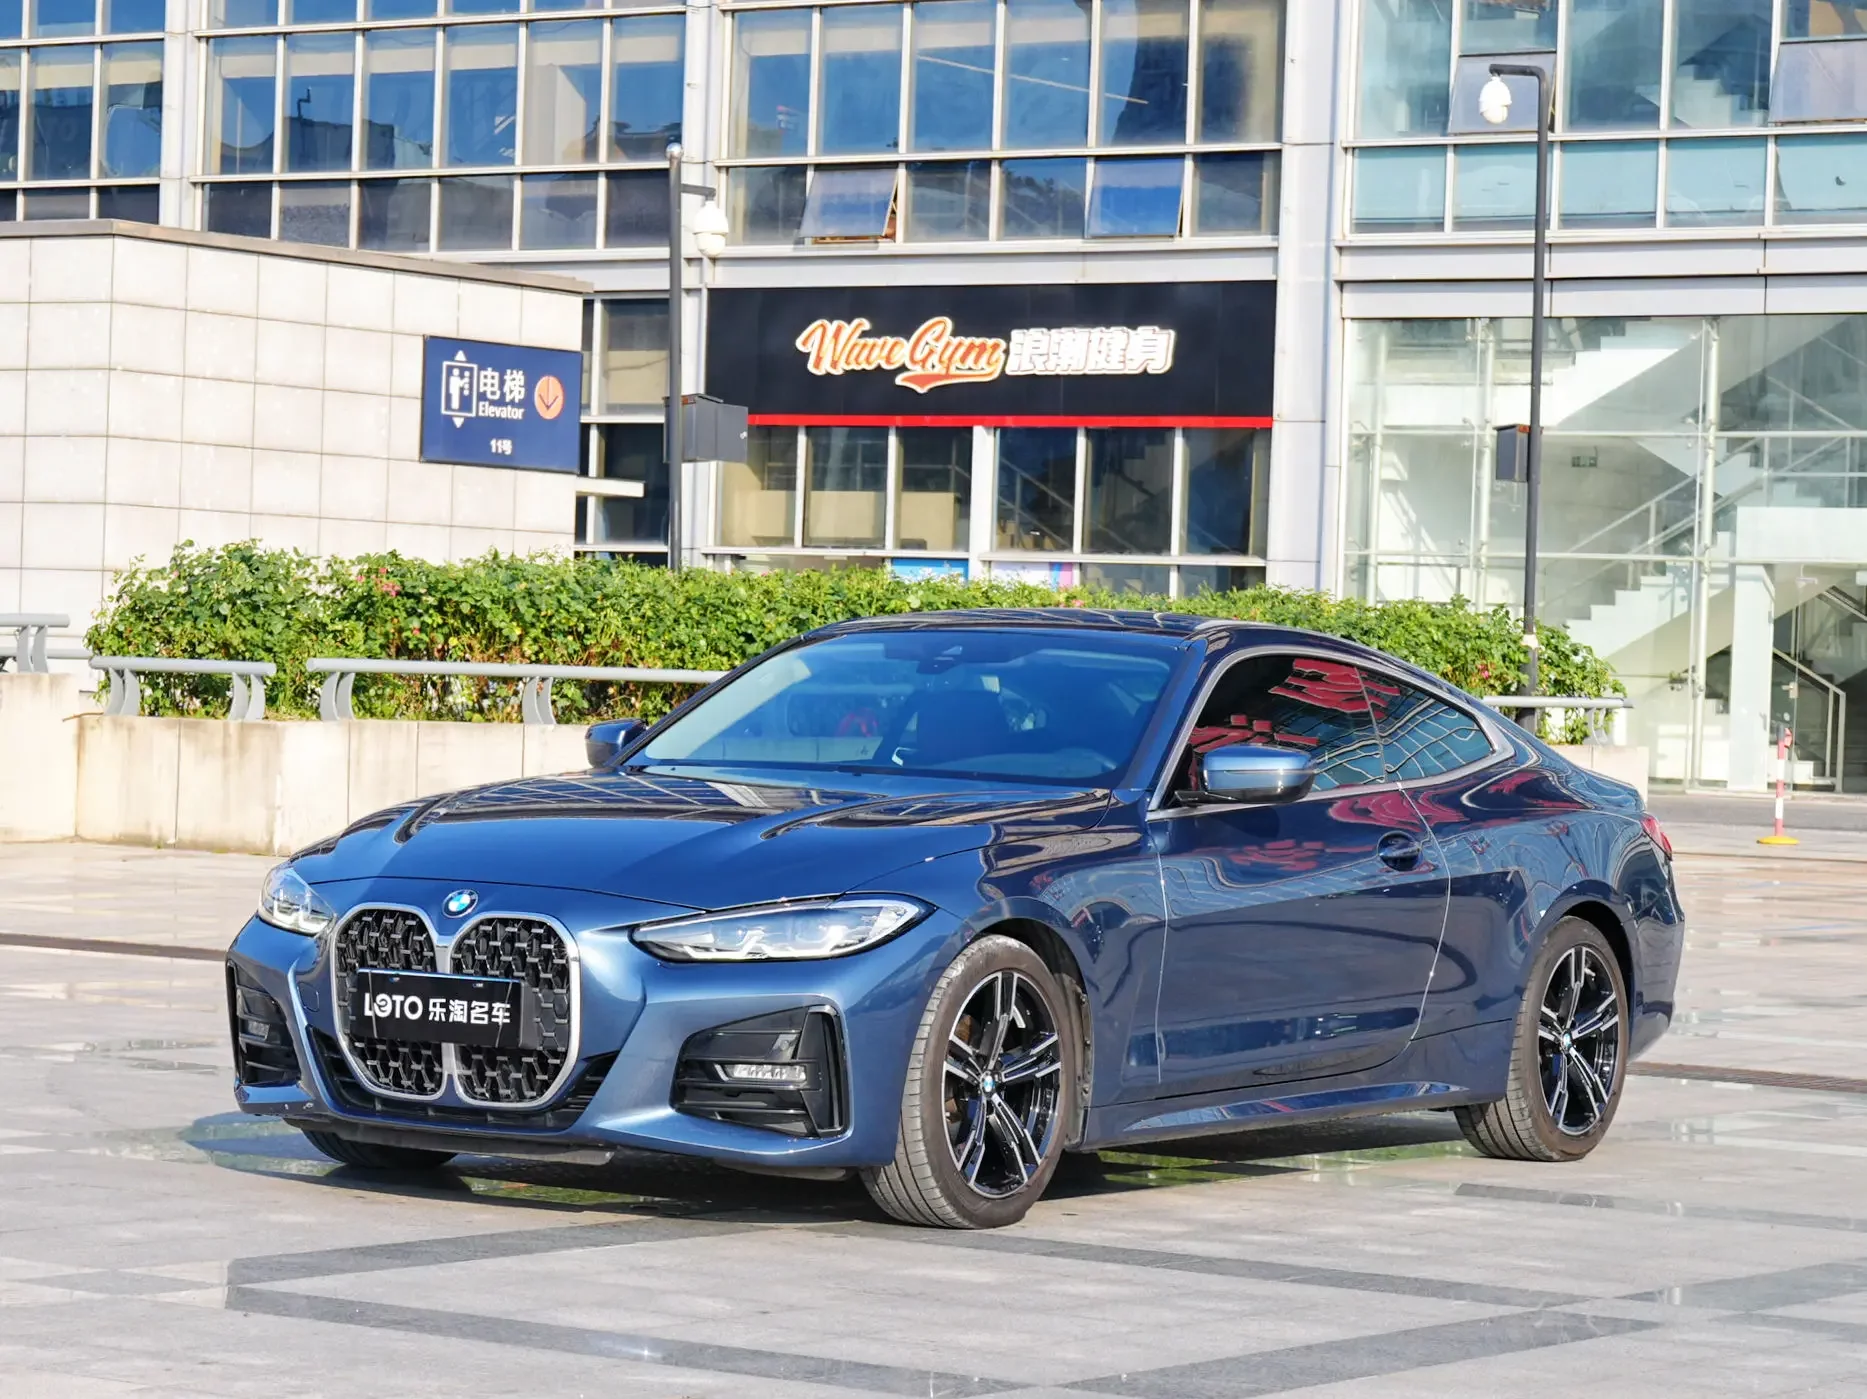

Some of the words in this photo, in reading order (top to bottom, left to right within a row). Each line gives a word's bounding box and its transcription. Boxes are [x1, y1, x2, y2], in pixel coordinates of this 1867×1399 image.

[796, 317, 907, 375] Wave
[896, 316, 1006, 393] Gym
[1005, 325, 1176, 375] 浪潮健身
[479, 367, 526, 403] 电梯
[478, 402, 525, 419] Elevator
[364, 993, 423, 1020] LOTO
[428, 998, 511, 1025] 乐淘名车
